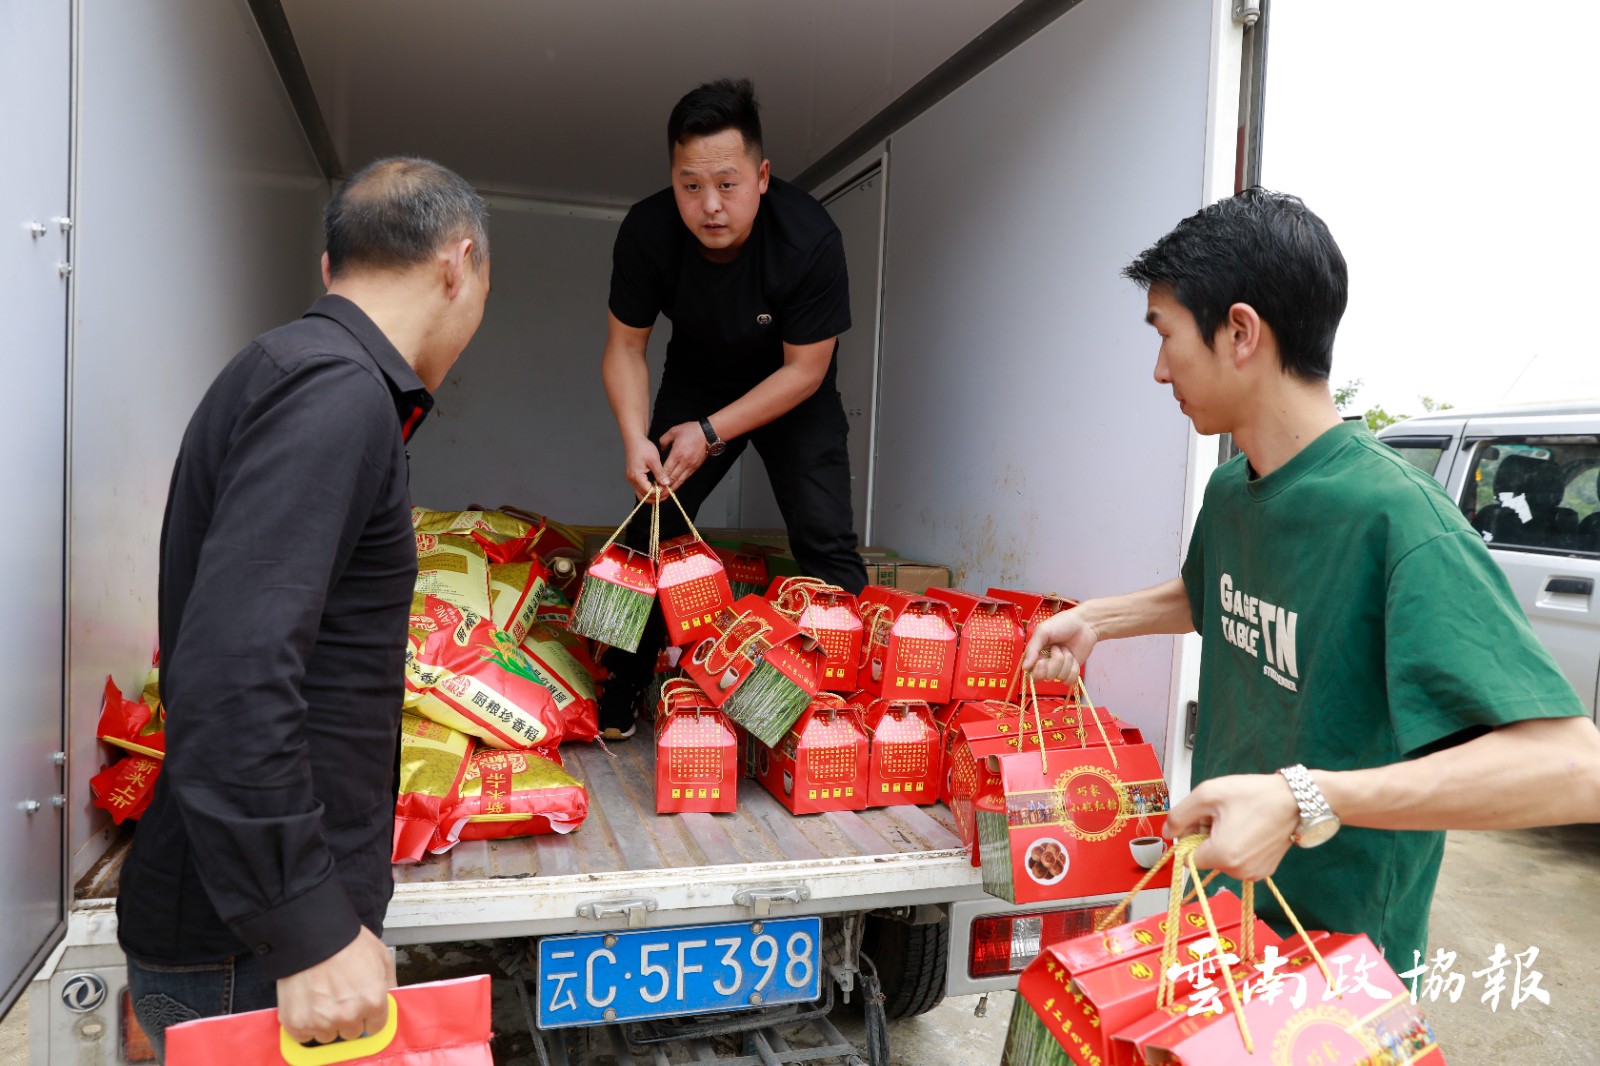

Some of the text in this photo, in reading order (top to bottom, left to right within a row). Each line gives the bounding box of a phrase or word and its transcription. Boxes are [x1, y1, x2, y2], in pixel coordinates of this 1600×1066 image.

[1221, 615, 1260, 658] TABLE
[1259, 600, 1299, 678] TN
[471, 690, 540, 742] 厨粮珍香稻
[108, 759, 158, 809] 新米上市
[484, 773, 507, 814] 新米上市
[1077, 784, 1101, 797] 巧家
